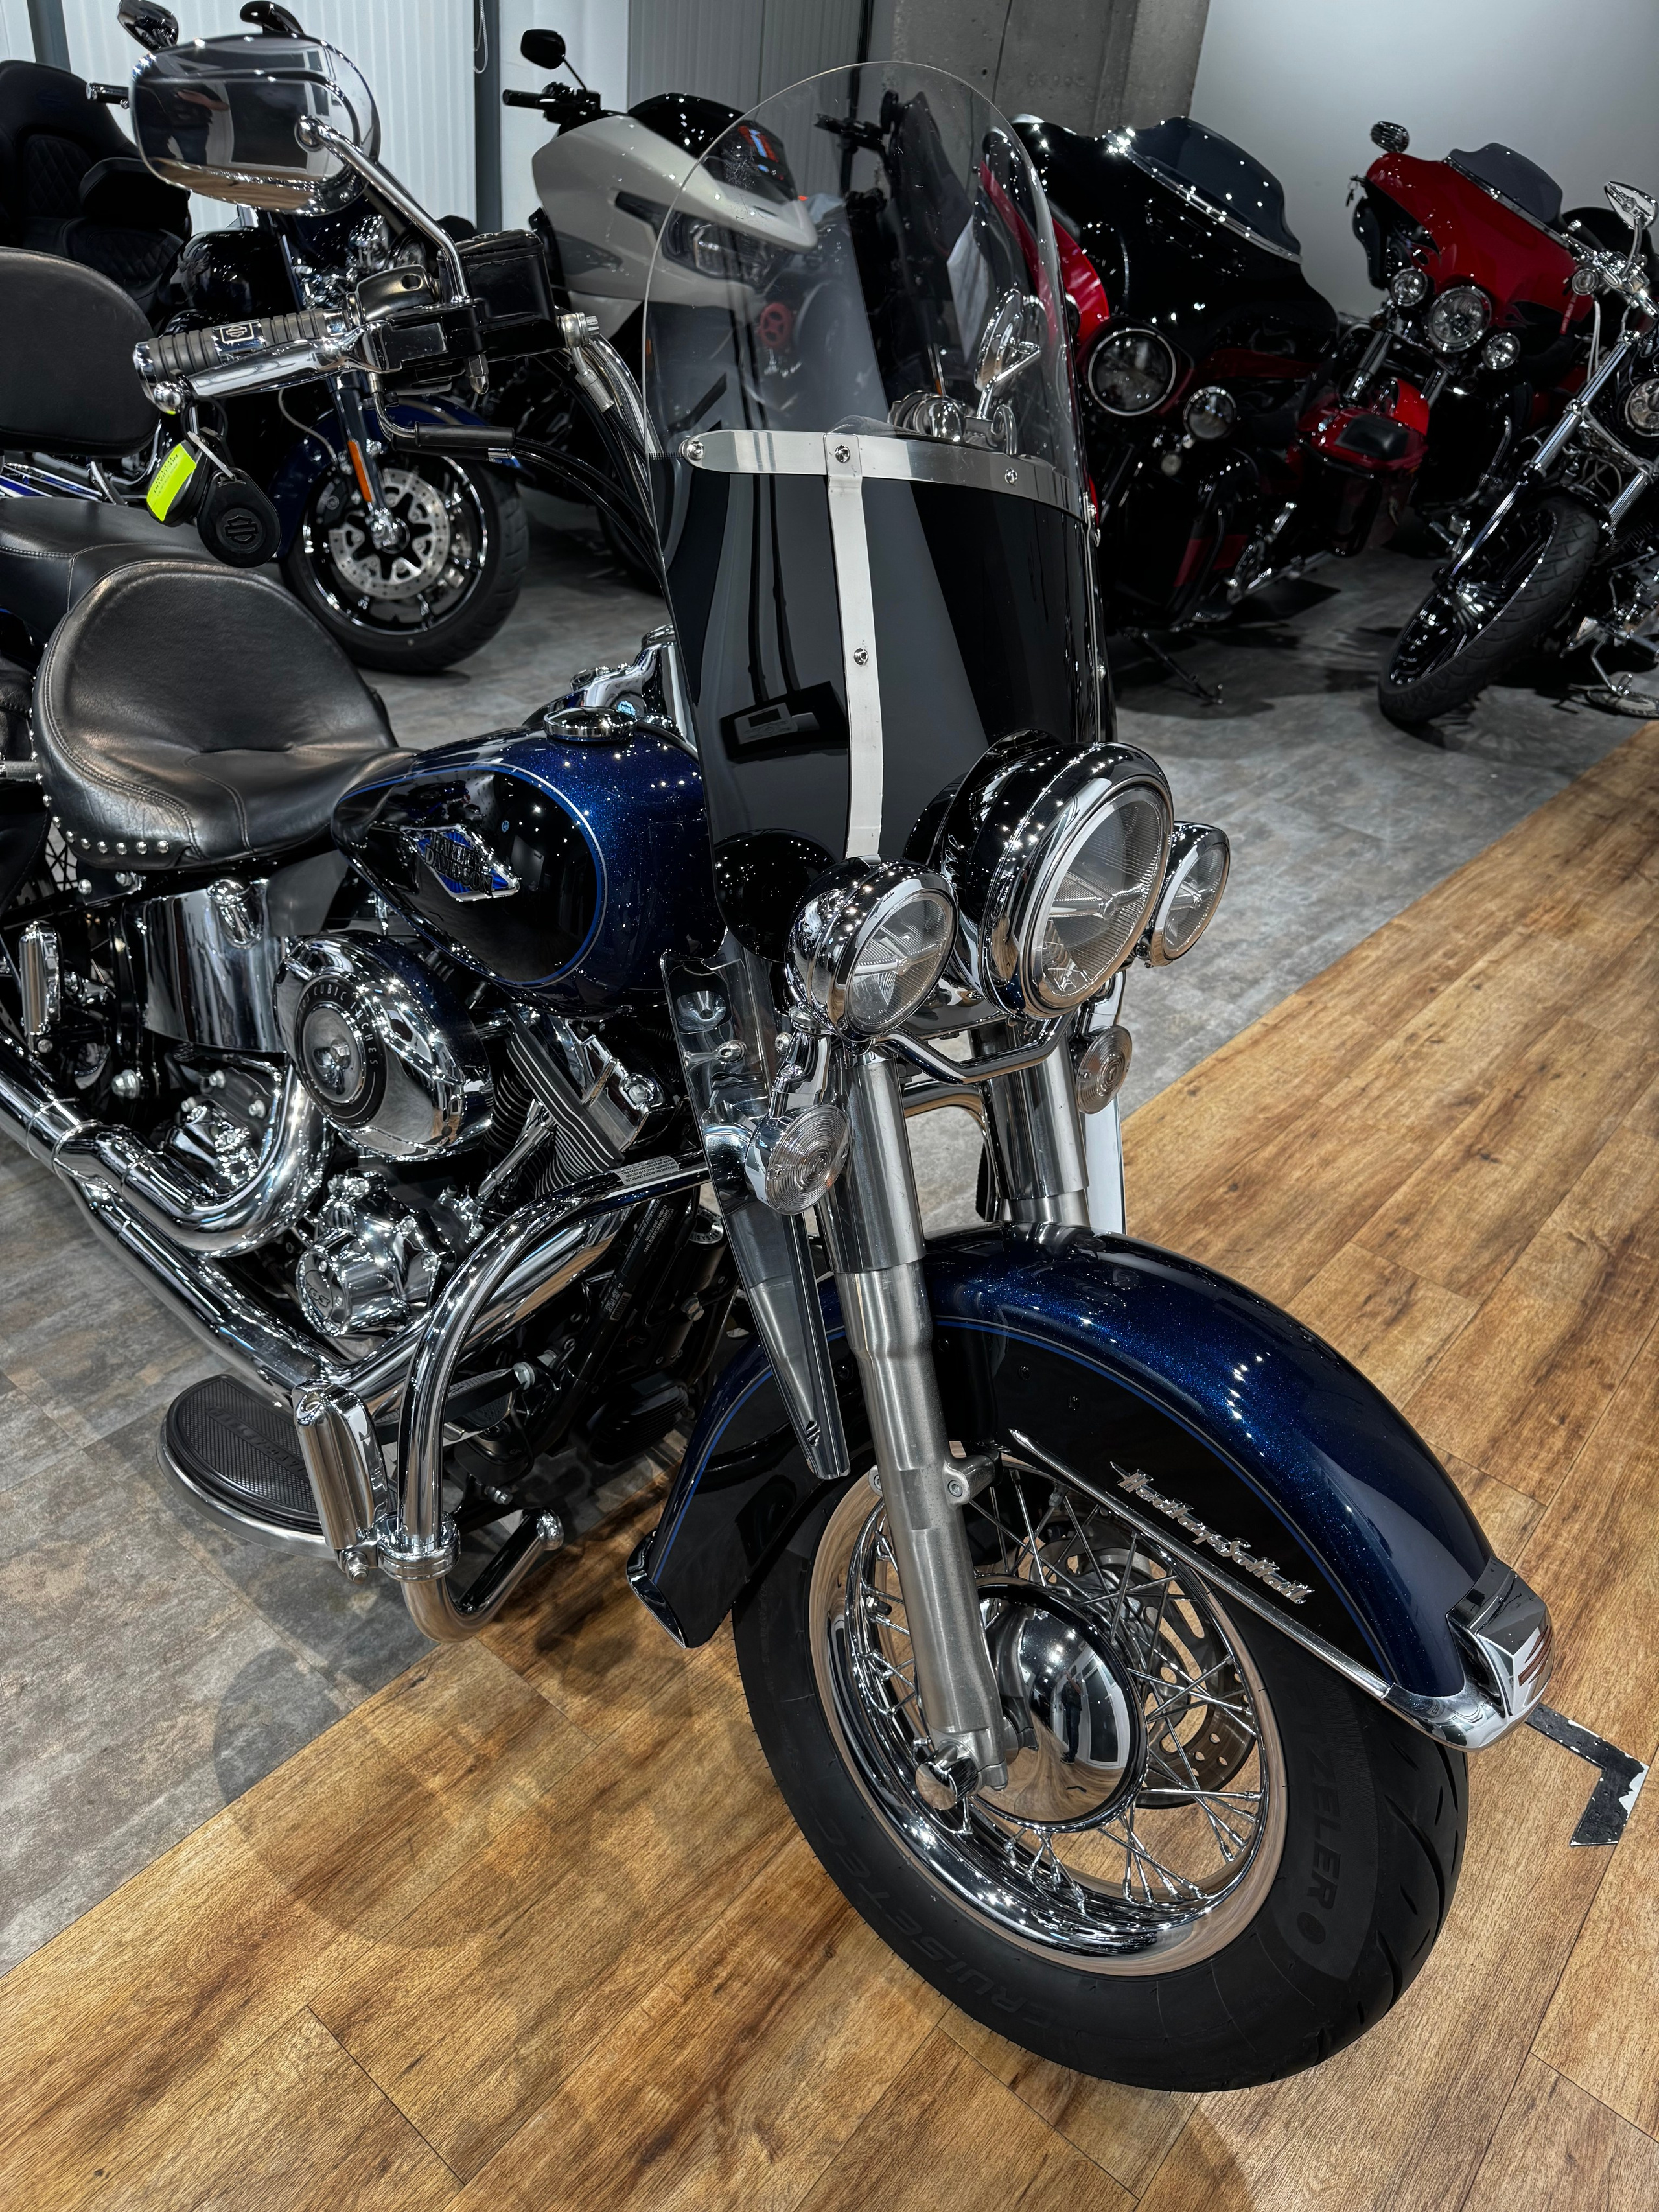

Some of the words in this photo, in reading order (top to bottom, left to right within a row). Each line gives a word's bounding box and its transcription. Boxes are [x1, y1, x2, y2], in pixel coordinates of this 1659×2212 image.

[424, 845, 493, 898] DAVIDSON
[313, 983, 347, 1001] CUBIC
[349, 1000, 378, 1065] INCHES
[1109, 1461, 1228, 1552] Heritage
[1223, 1538, 1314, 1605] Softail
[814, 1815, 1058, 2028] CRUISETEC
